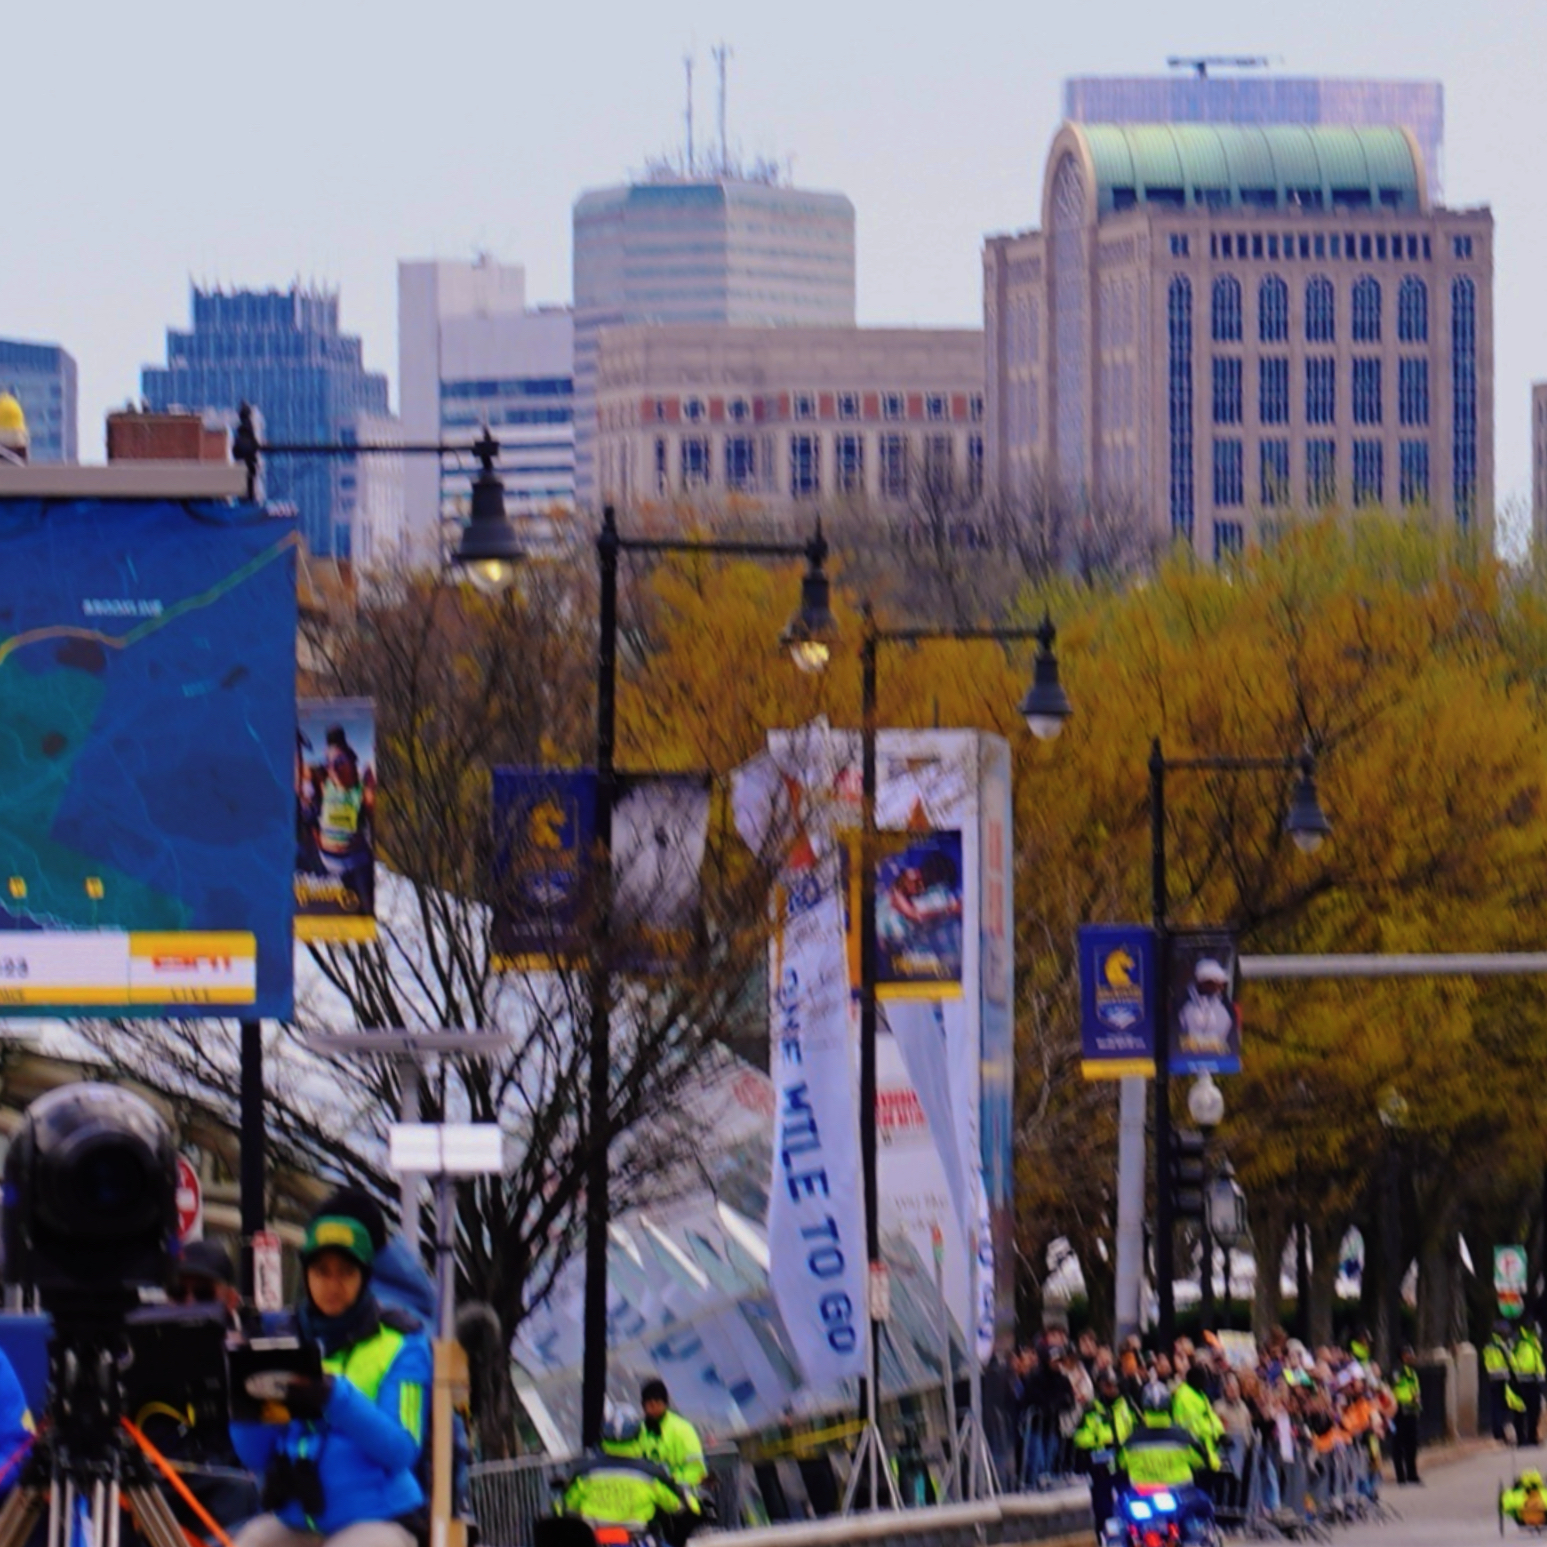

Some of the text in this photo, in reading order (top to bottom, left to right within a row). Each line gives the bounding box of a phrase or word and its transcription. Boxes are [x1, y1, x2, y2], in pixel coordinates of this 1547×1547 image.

[781, 1080, 830, 1203] MILE
[801, 1212, 846, 1281] TO
[818, 1290, 857, 1356] GO
